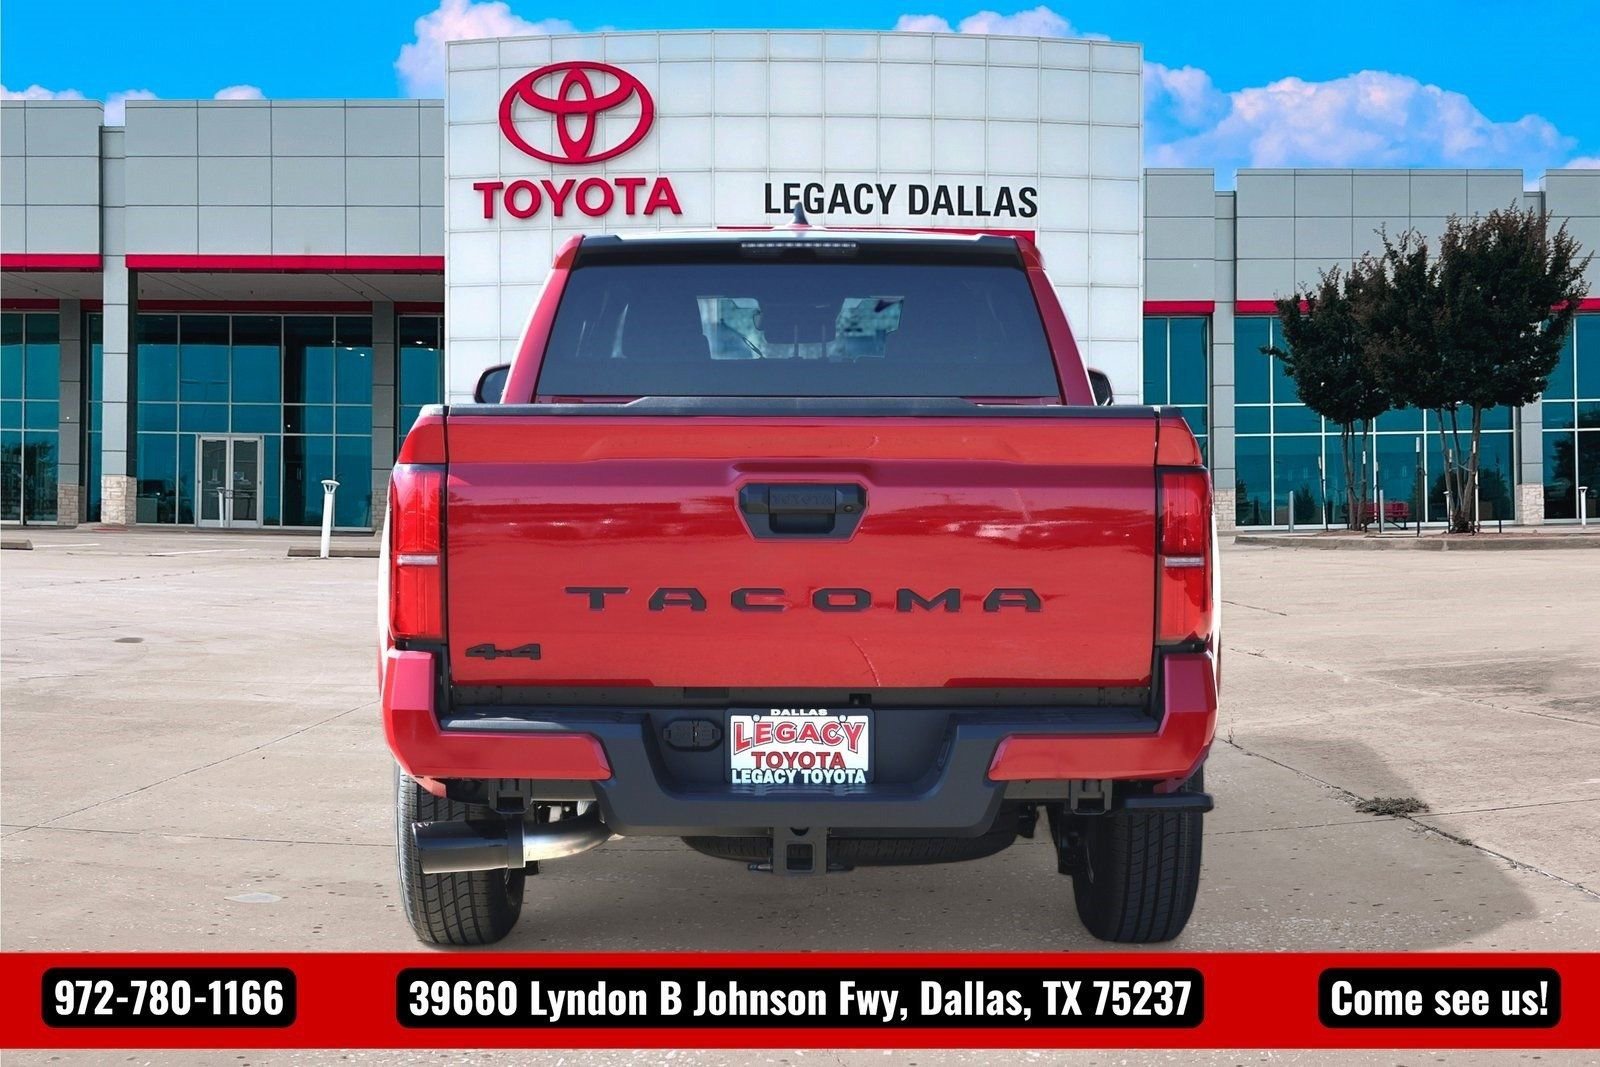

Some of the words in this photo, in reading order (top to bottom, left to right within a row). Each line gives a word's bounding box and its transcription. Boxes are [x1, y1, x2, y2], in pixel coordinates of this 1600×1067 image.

[472, 177, 682, 220] TOYOTA
[764, 182, 896, 216] LEGACY
[907, 184, 1038, 218] DALLAS
[564, 586, 1042, 613] TACOMA
[770, 708, 828, 716] DALLAS
[733, 721, 866, 755] LEGACY
[751, 751, 846, 769] TOYOTA
[731, 768, 798, 784] LEGACY
[801, 768, 867, 784] TOYOTA
